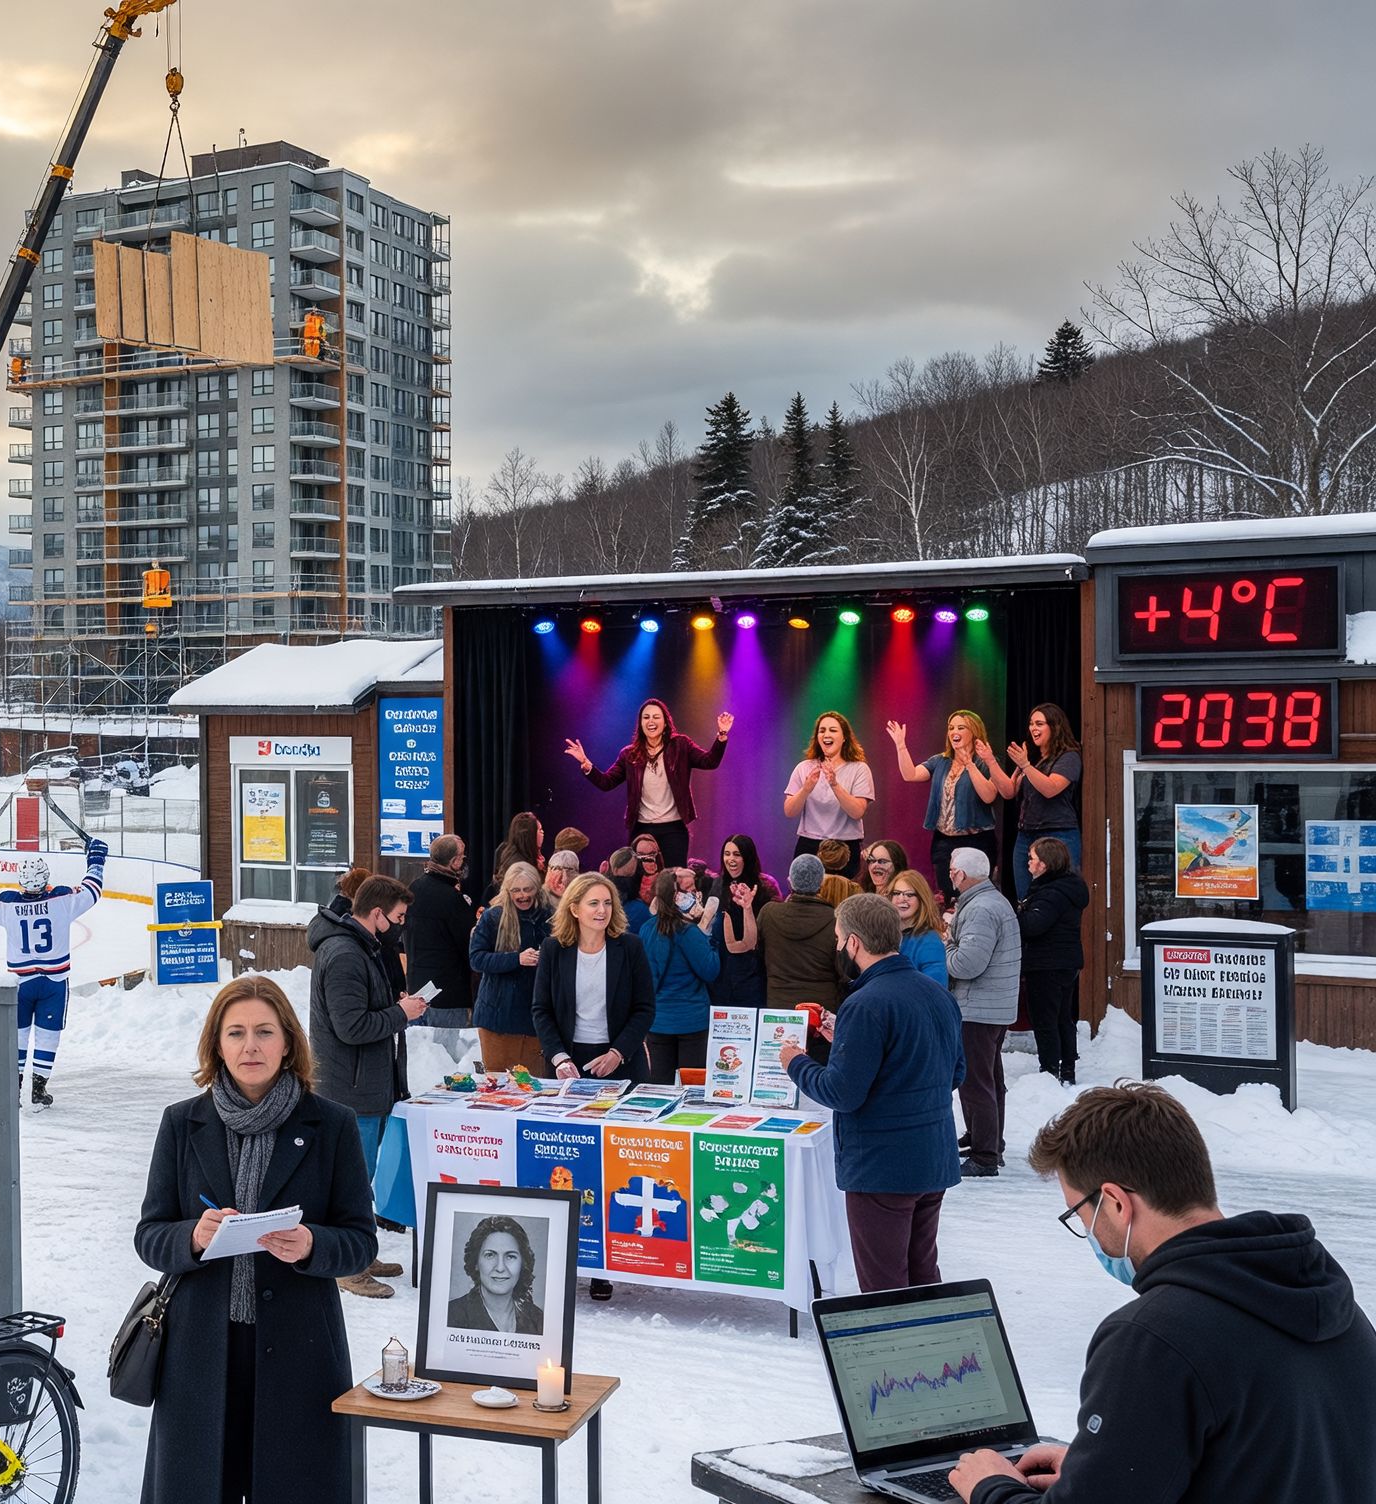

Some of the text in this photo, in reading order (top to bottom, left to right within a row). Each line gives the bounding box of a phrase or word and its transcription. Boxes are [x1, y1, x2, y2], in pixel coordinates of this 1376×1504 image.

[1134, 576, 1305, 642] +4°C
[1154, 691, 1323, 749] 2038
[20, 918, 53, 954] 13
